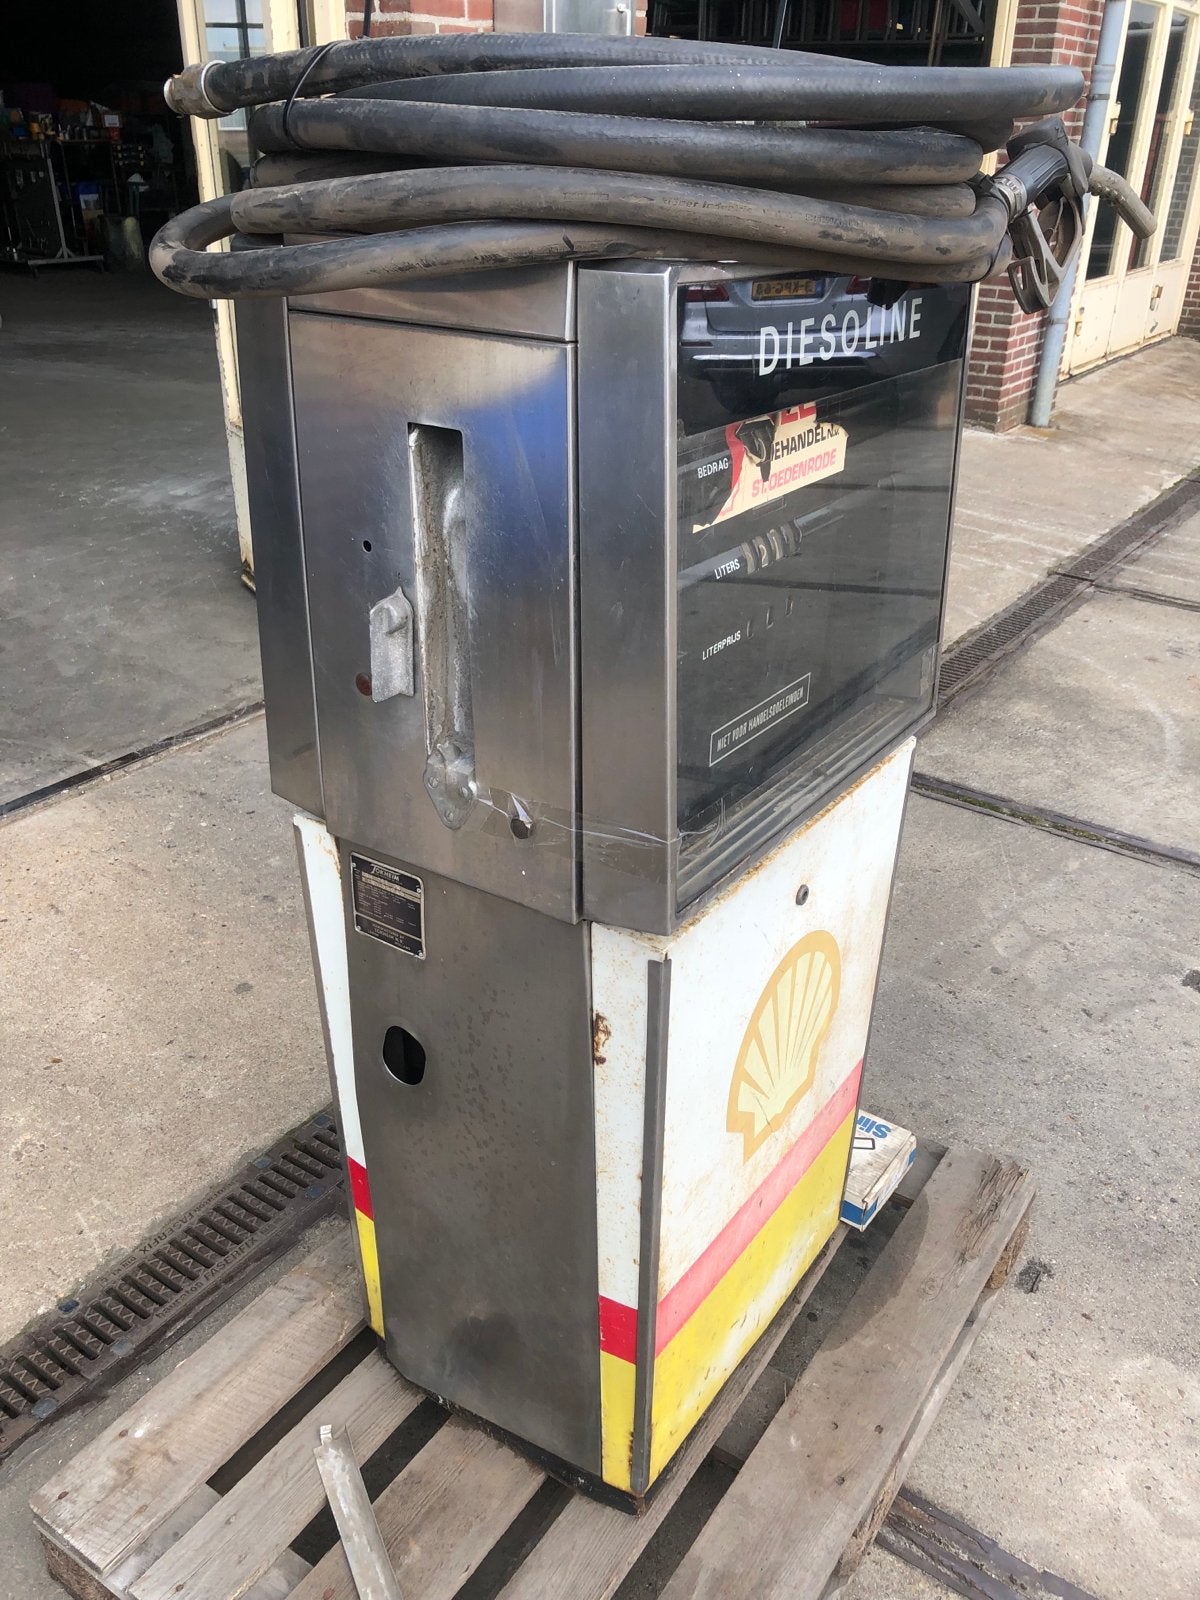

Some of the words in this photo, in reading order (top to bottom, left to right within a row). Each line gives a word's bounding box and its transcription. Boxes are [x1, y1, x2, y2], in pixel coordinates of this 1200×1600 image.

[759, 298, 922, 376] DIESOLINE
[698, 457, 729, 478] BEDRAG
[714, 558, 740, 580] LITERS
[702, 630, 741, 661] LITERPRIJS
[717, 732, 731, 752] NIET
[732, 722, 747, 742] VOOR
[204, 1237, 257, 1280] FASERFIX
